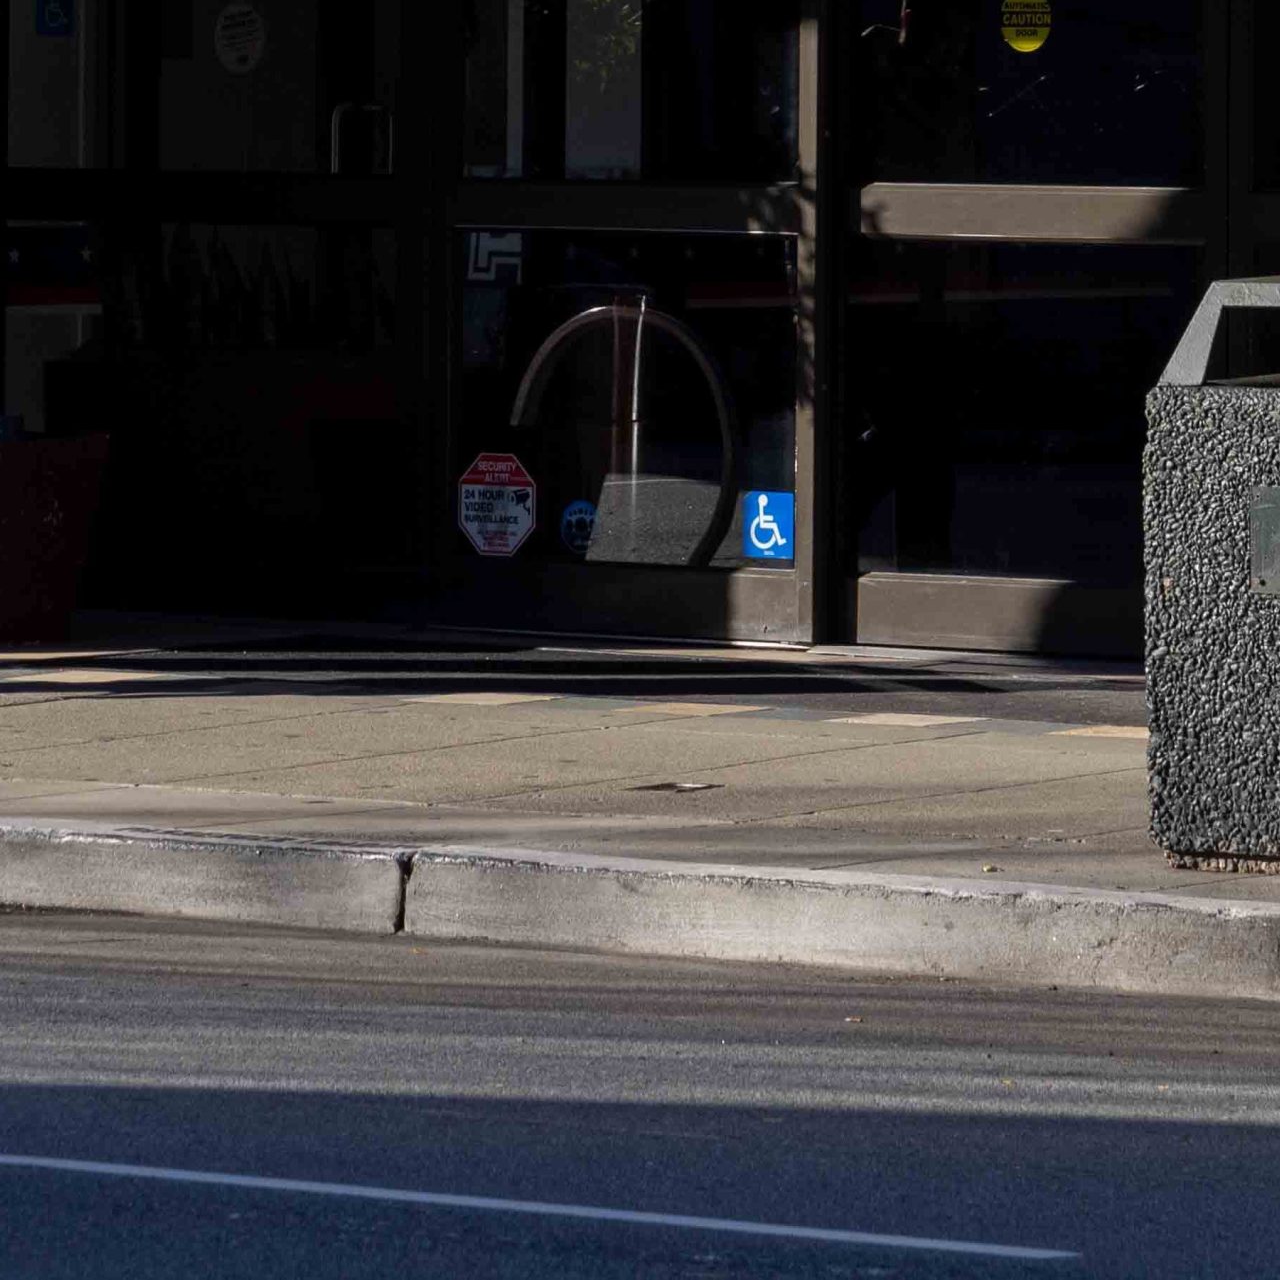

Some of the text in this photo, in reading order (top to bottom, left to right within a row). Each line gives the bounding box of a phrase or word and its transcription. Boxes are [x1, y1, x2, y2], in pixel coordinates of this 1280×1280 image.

[1002, 13, 1052, 25] CAUTION
[478, 461, 516, 472] SECURITY
[485, 472, 510, 482] ALERT
[464, 488, 505, 501] 24 HOUR
[464, 501, 494, 513] VIDEO
[464, 514, 519, 525] SURVEILLANCE
